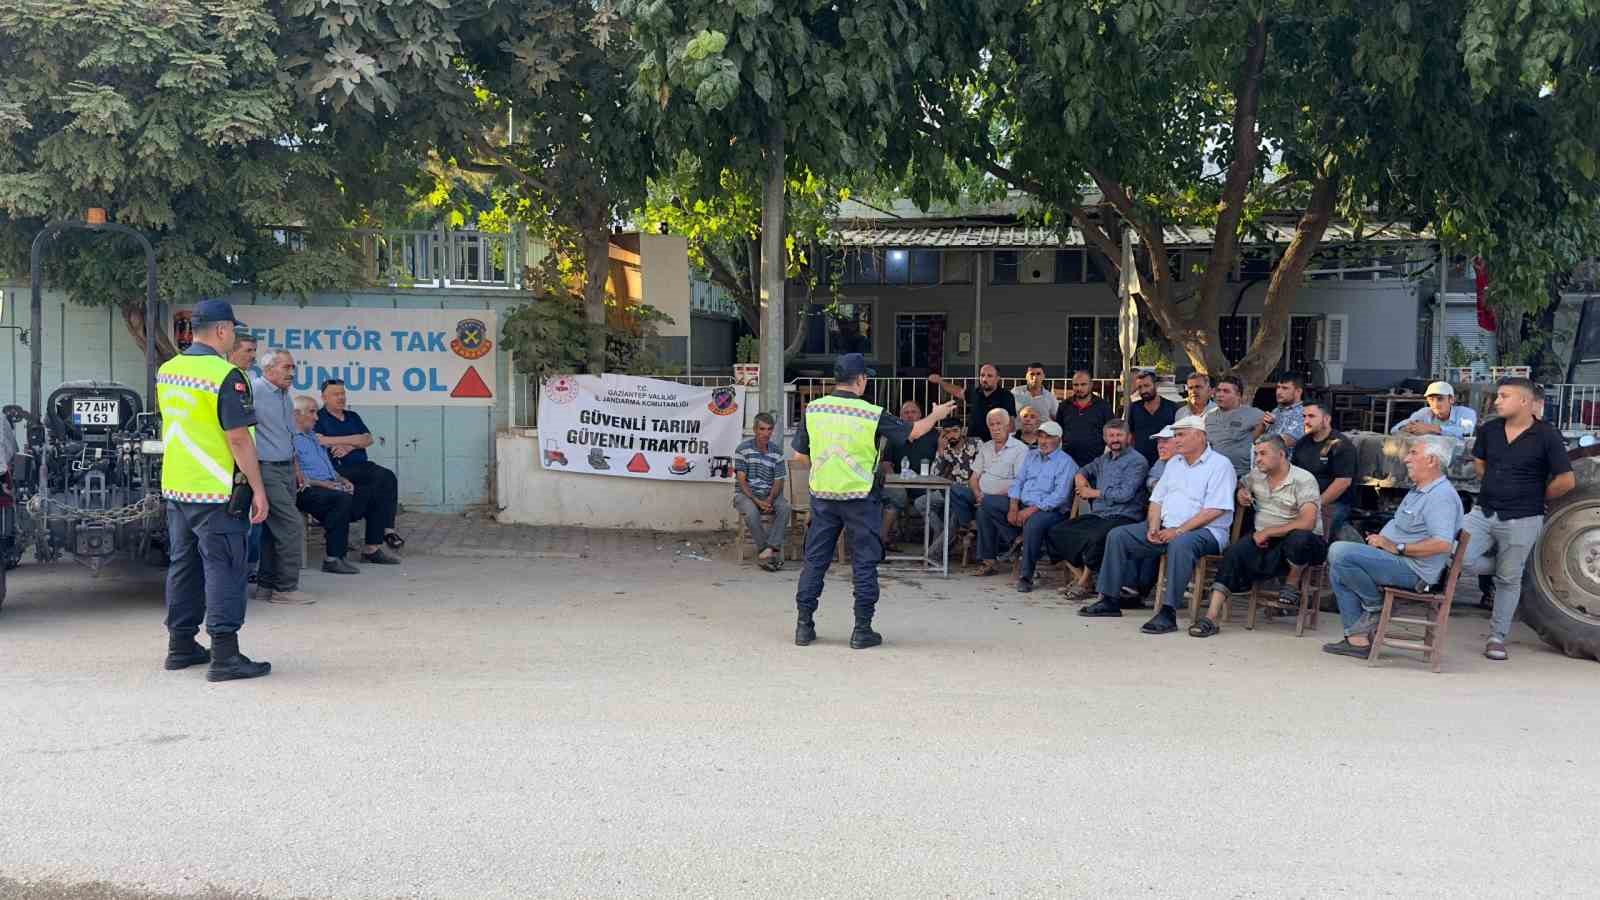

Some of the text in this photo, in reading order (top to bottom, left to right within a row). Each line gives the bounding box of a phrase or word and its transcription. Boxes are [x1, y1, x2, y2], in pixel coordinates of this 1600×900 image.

[234, 327, 382, 351] FLEKTÖR
[390, 331, 447, 352] TAK
[251, 360, 447, 392] ÜNÜR OL
[76, 402, 116, 412] 27 AHY
[603, 396, 640, 405] JANDARMA
[87, 413, 108, 423] 163
[580, 409, 700, 433] GÜVENLİ TARIM
[567, 428, 708, 454] GÜVENLİ TRAKTÖR
